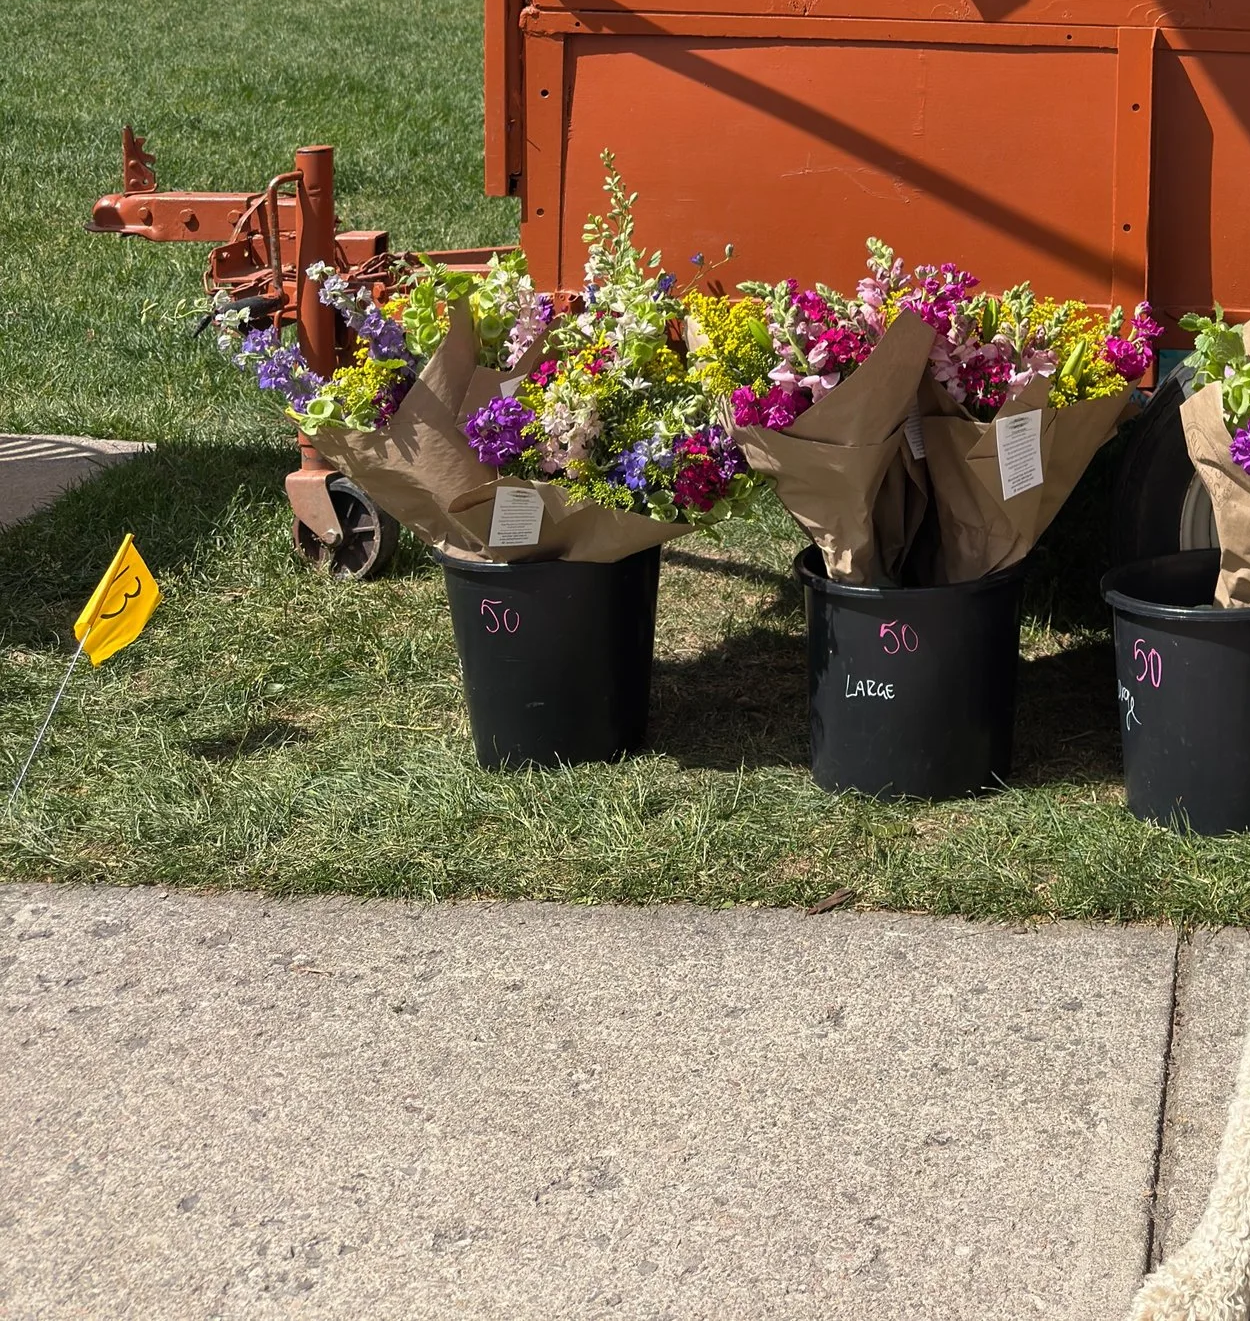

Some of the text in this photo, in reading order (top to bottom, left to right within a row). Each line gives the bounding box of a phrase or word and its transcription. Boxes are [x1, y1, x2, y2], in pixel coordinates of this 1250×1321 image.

[479, 598, 521, 634] 50
[879, 620, 919, 655] 50
[1133, 638, 1163, 689] 50
[845, 674, 895, 700] LARGE
